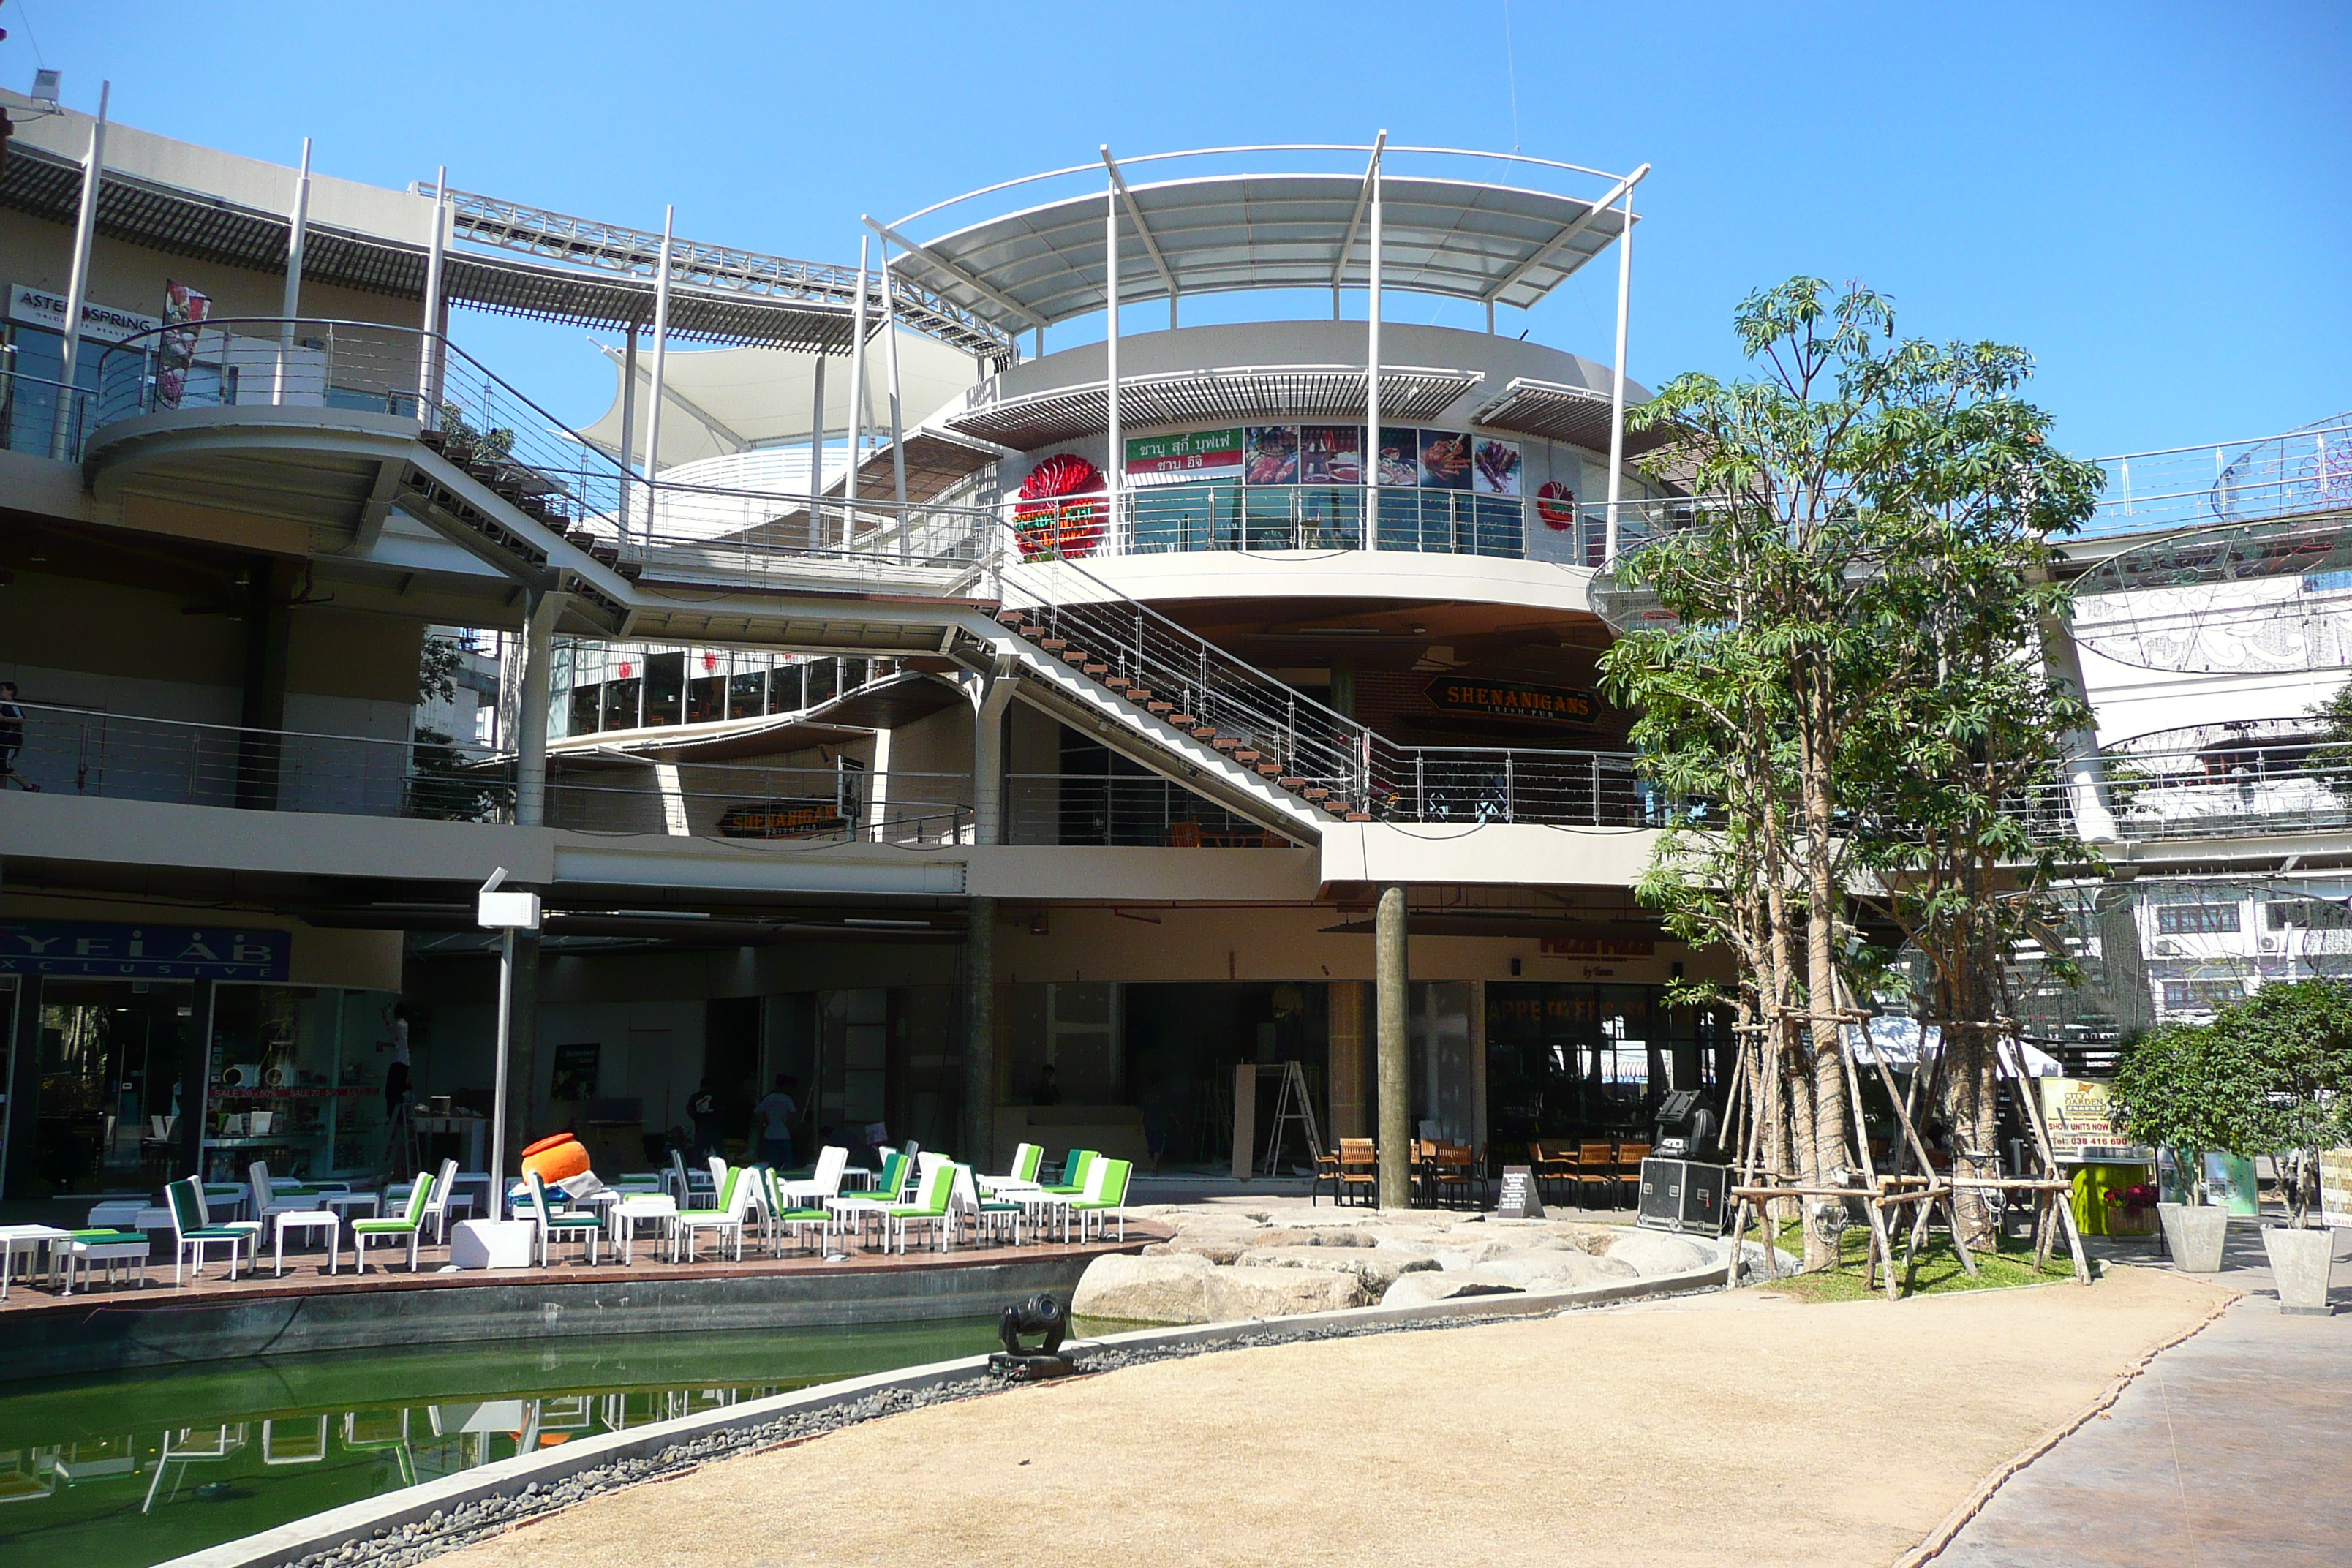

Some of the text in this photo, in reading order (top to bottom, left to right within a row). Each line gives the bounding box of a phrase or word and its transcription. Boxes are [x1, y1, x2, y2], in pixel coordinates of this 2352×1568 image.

[91, 309, 151, 331] SPRING
[1139, 443, 1165, 457] ชาบู
[1447, 686, 1588, 715] SHENANIGANS
[1488, 705, 1554, 718] IRISH PUB
